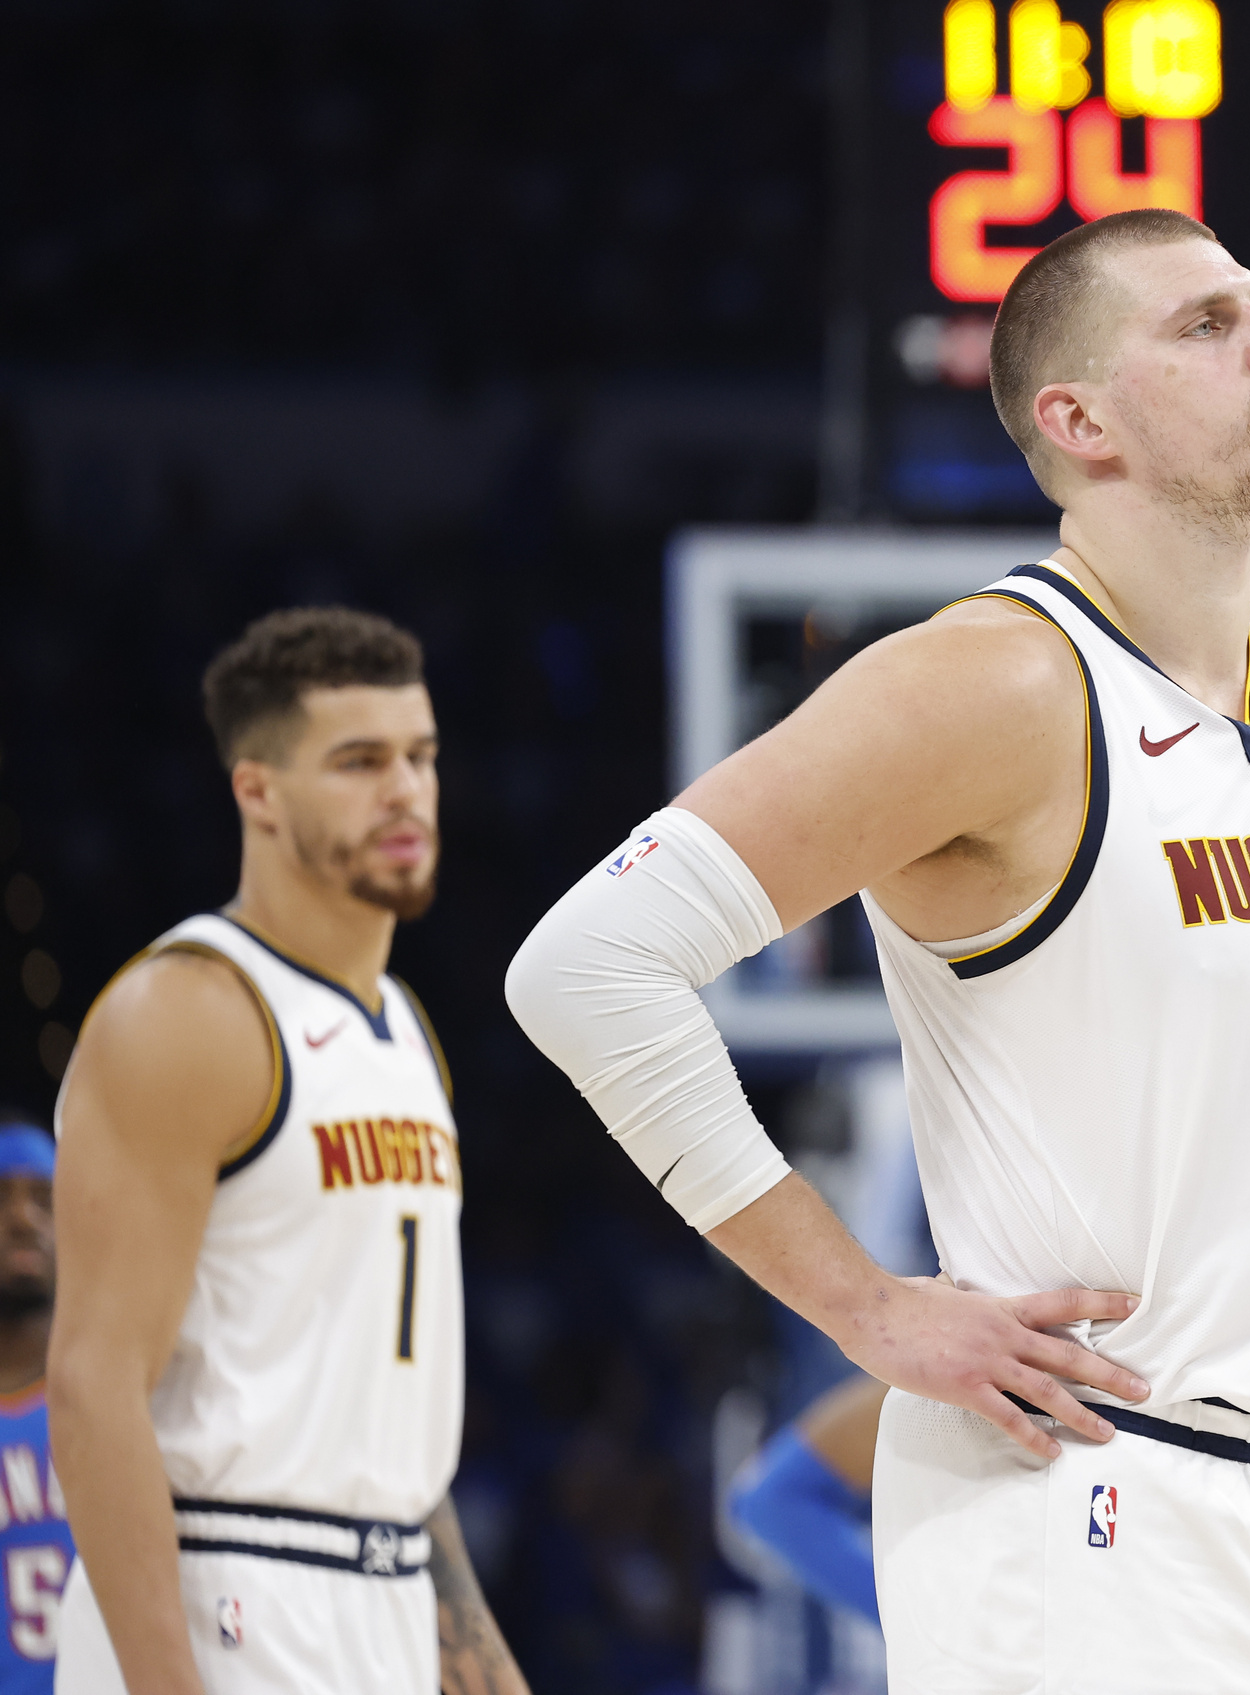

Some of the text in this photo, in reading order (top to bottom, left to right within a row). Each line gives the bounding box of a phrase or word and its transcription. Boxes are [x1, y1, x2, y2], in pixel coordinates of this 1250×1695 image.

[928, 95, 1203, 303] 24
[396, 1213, 419, 1364] 1
[1090, 1533, 1105, 1545] NBA
